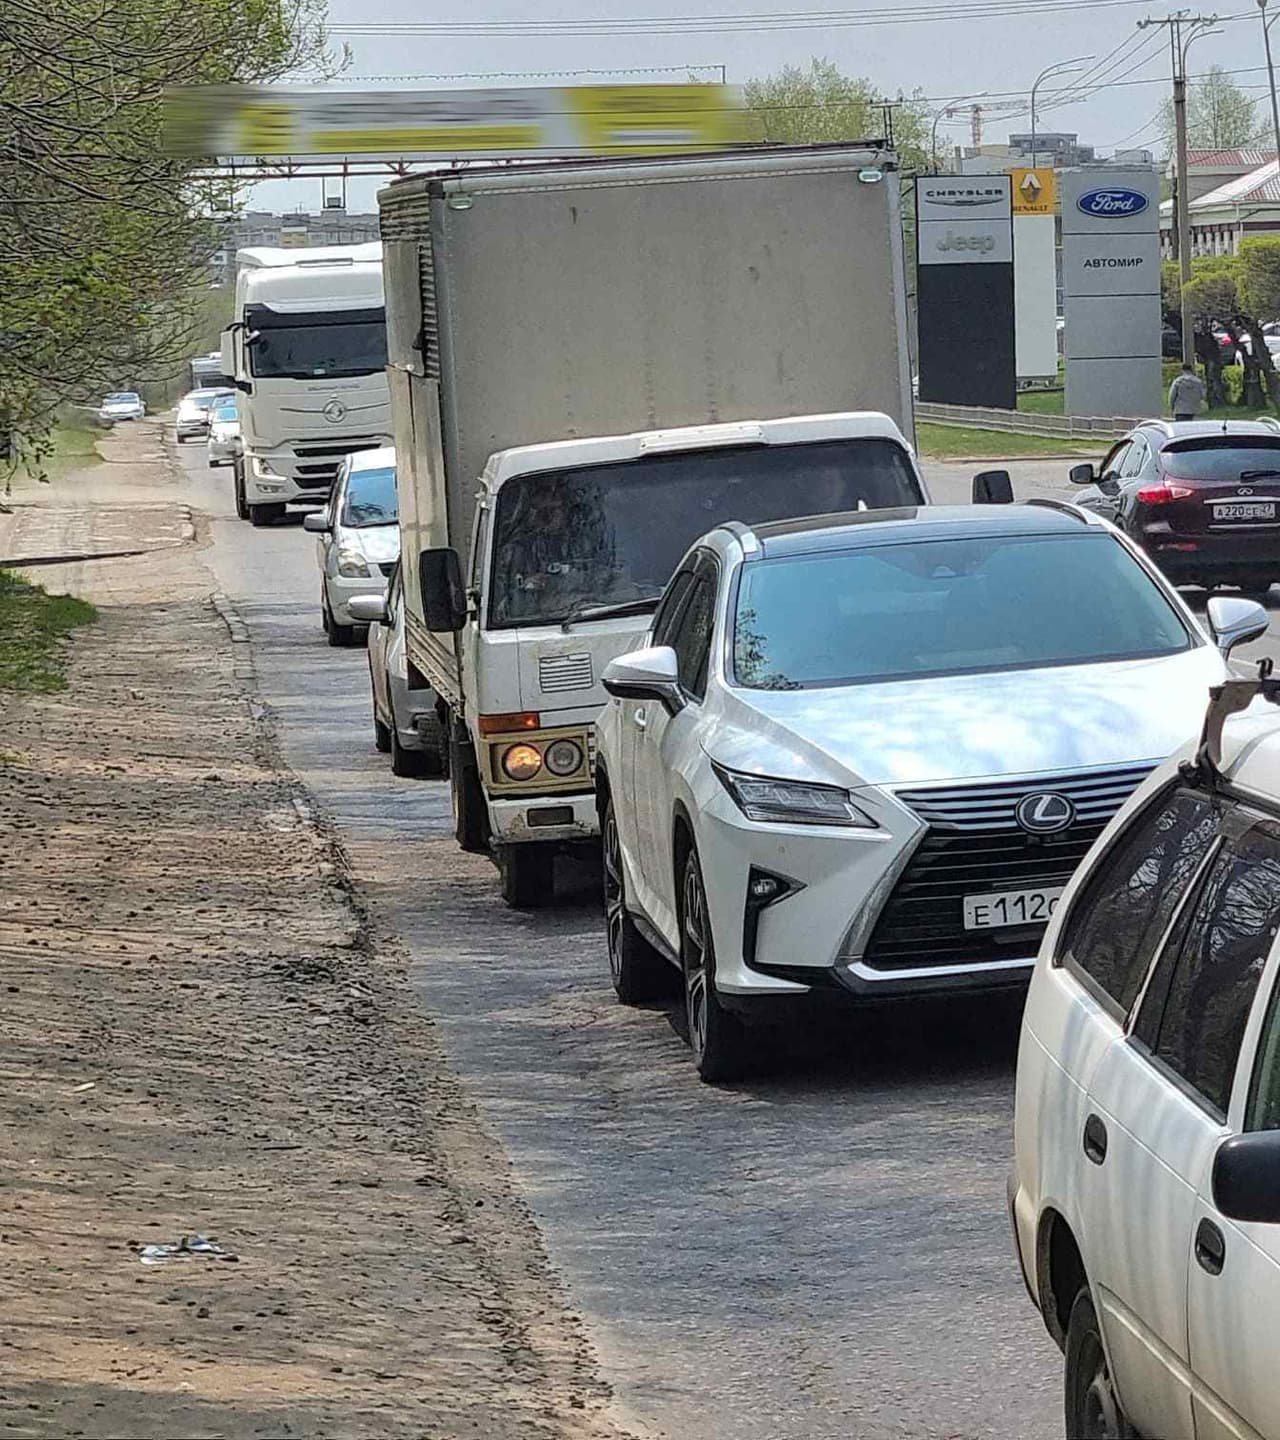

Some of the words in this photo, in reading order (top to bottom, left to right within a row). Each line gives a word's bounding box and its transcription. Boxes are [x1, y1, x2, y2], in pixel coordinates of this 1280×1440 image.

[926, 188, 1003, 197] CHRYSLER
[1091, 192, 1134, 211] Ford
[937, 230, 995, 255] Jeep
[1083, 257, 1143, 269] АВТОМИР
